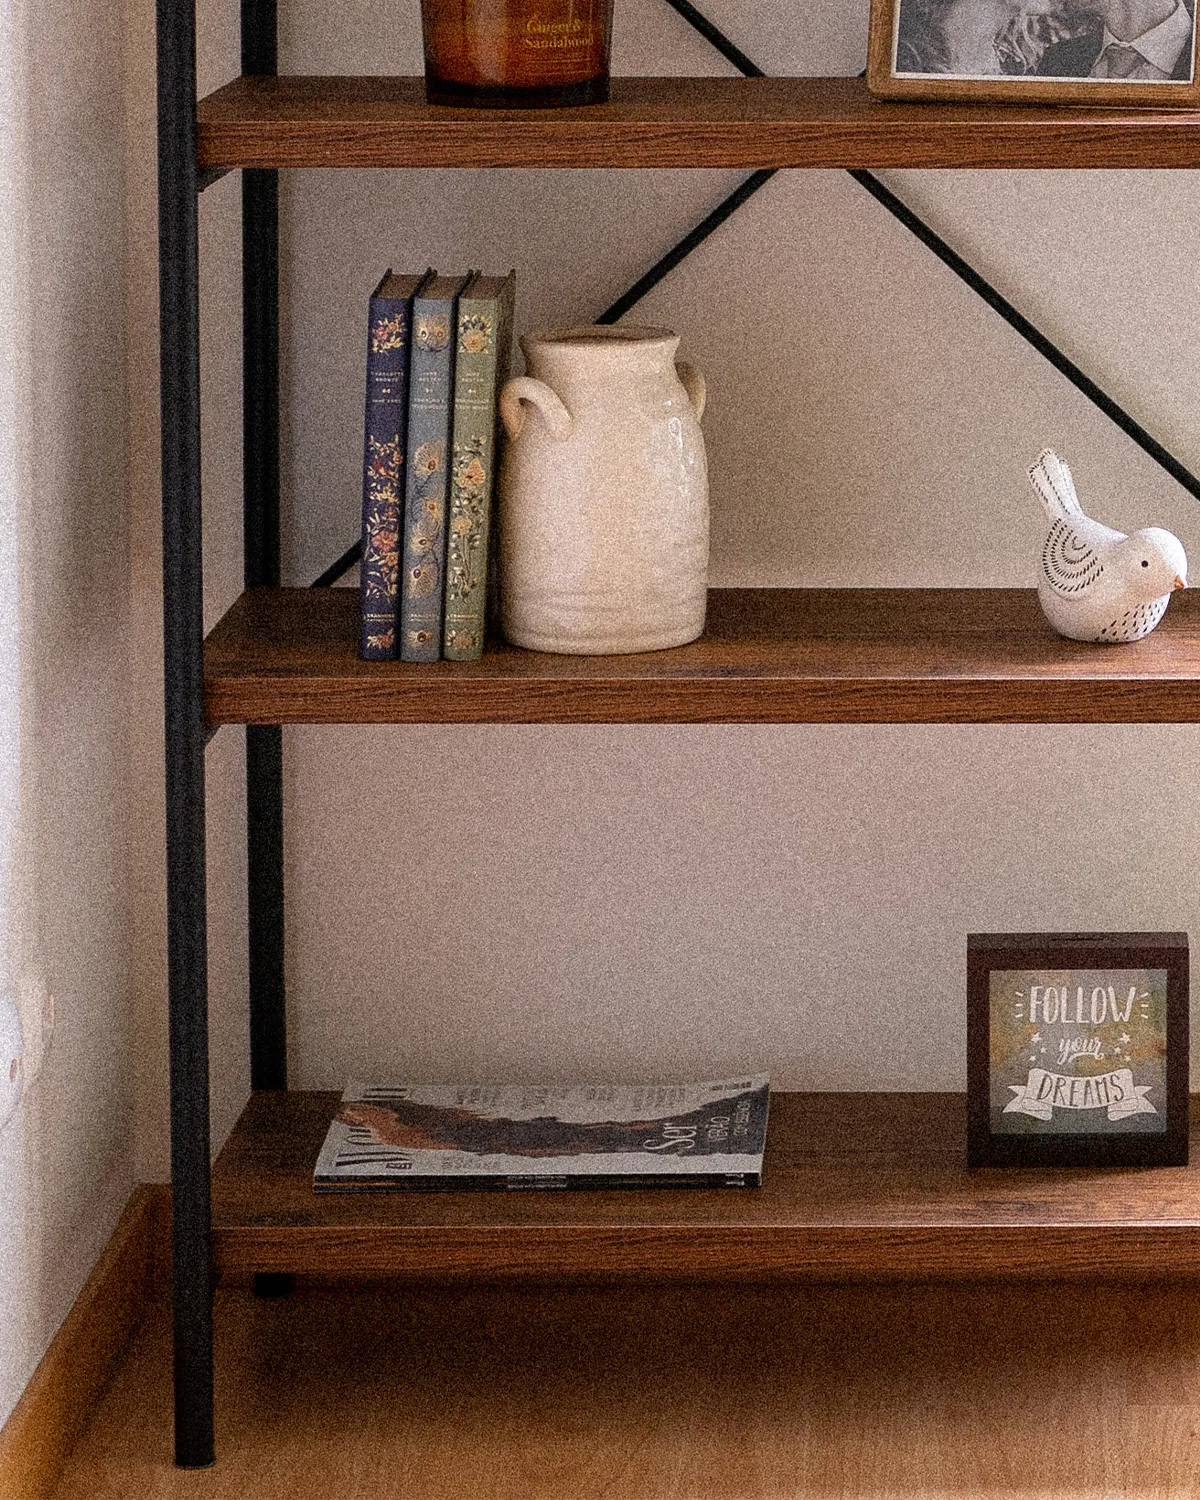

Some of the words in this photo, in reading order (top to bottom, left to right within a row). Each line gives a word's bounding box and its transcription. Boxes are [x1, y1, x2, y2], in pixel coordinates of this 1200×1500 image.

[524, 33, 595, 49] Sandalwood
[1029, 985, 1137, 1024] FOLLOW
[1056, 1035, 1105, 1066] your
[1037, 1073, 1125, 1107] DREAMS
[642, 1121, 698, 1151] Ser
